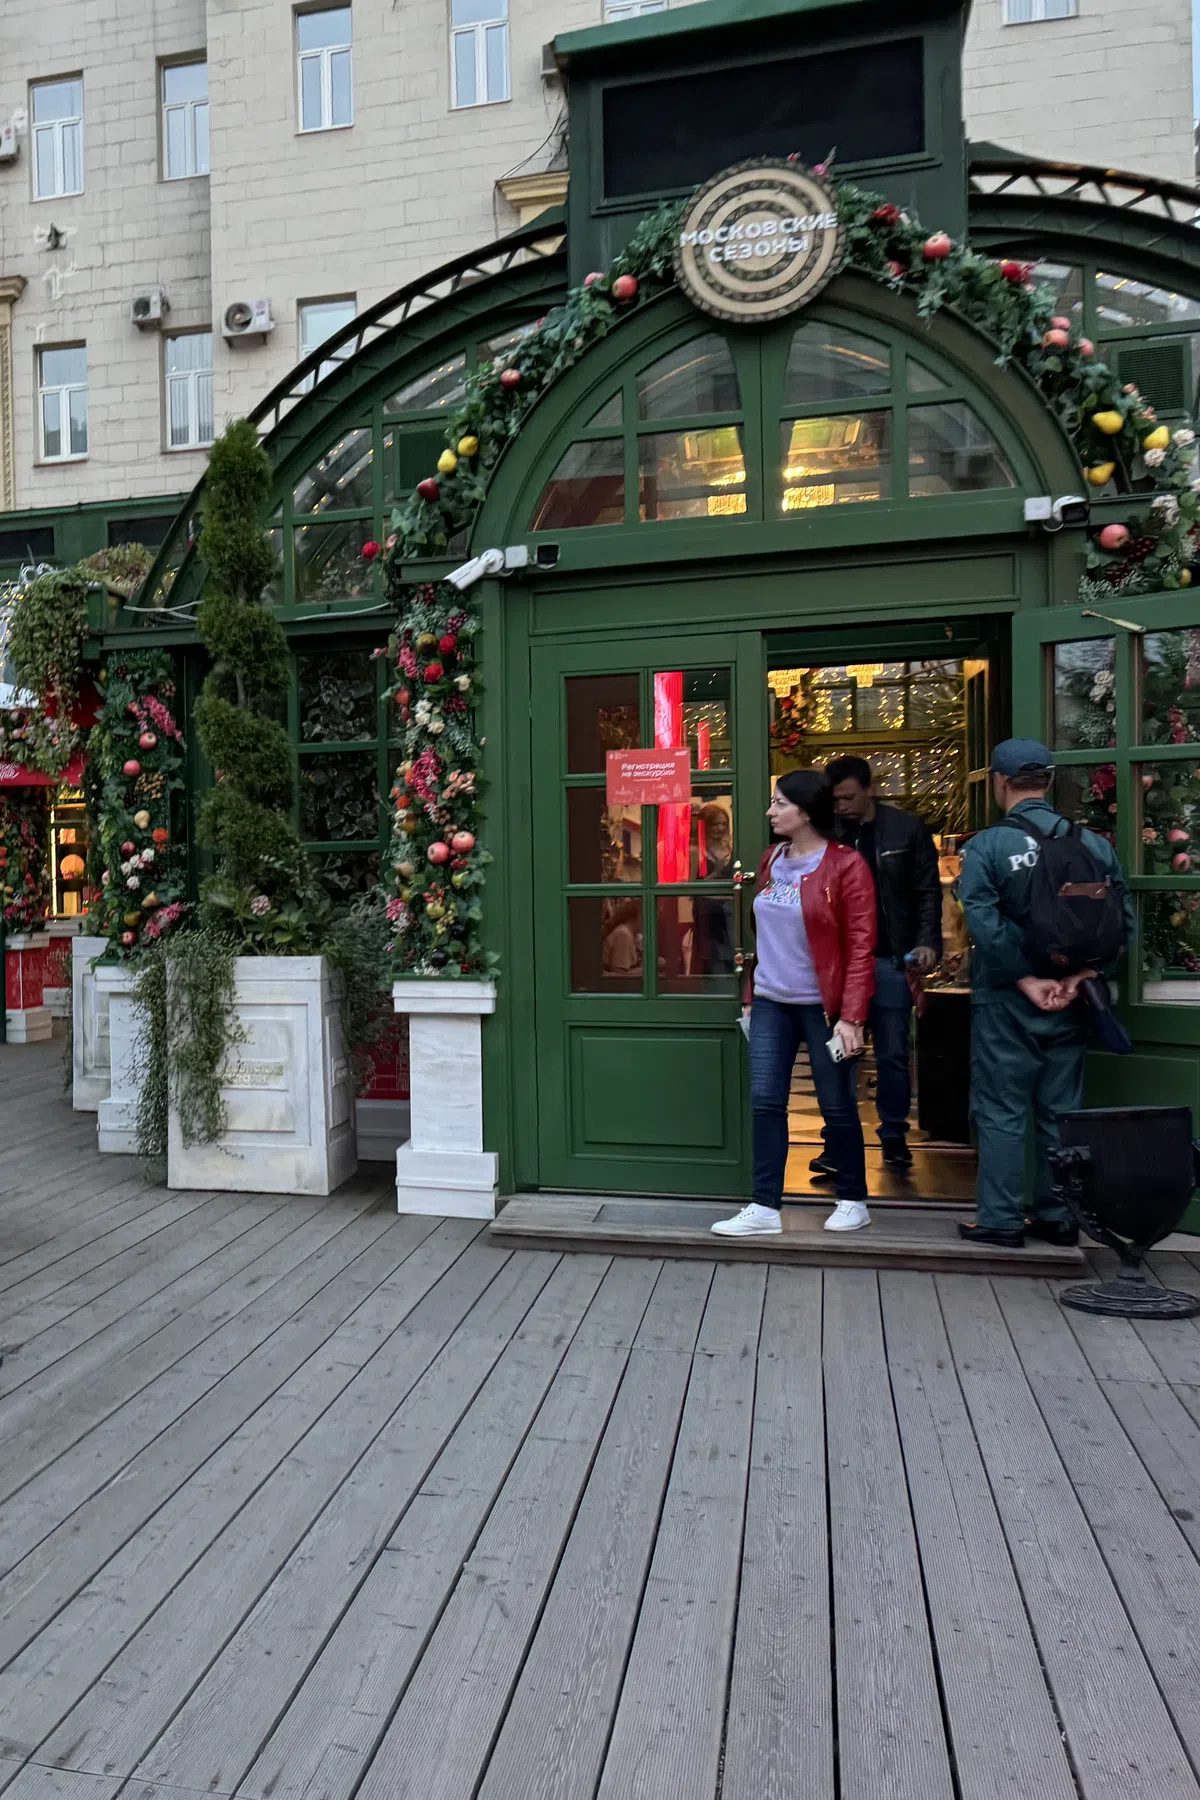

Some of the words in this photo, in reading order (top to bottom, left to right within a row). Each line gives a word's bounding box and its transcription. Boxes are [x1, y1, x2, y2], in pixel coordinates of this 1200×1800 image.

[680, 212, 838, 247] МОСКОВСКИЕ
[709, 236, 809, 263] СЕЗОНЫ
[621, 762, 675, 771] Регистрация
